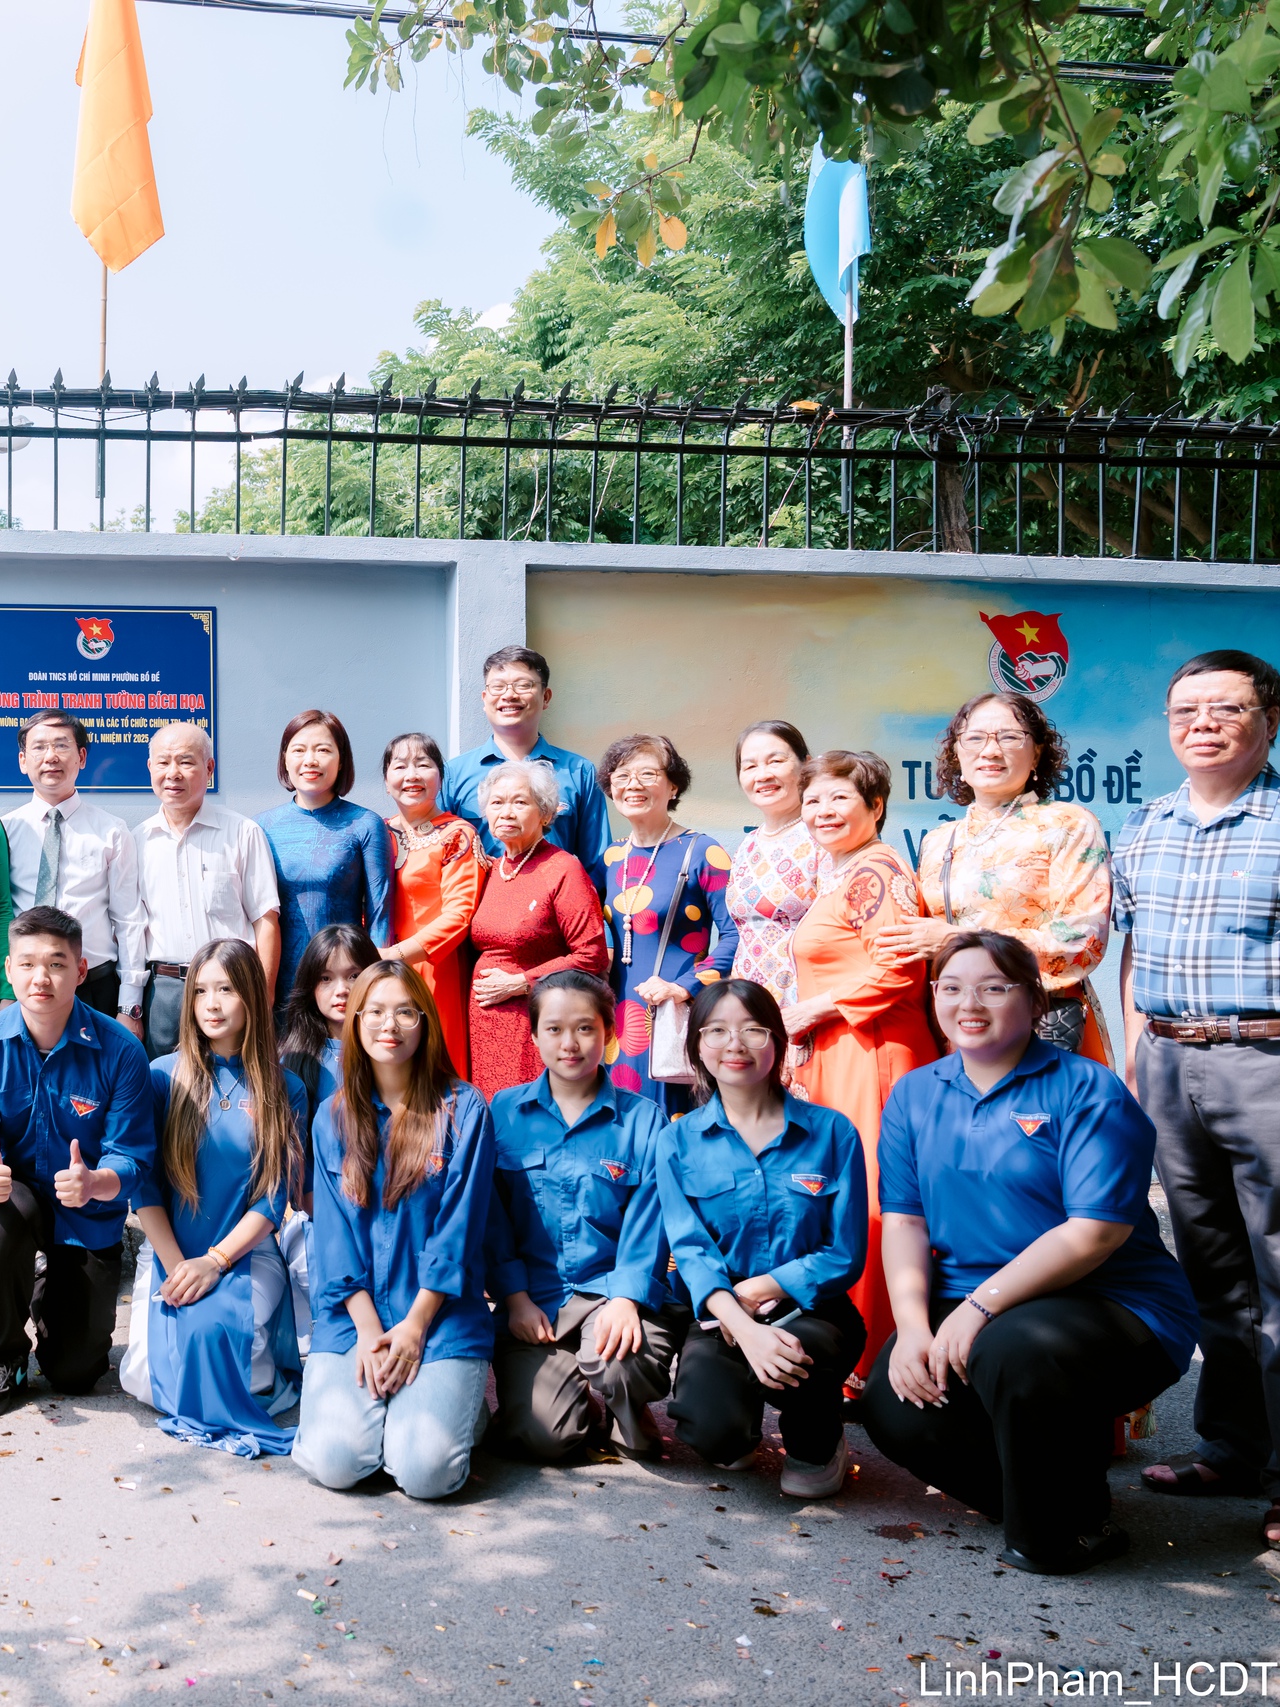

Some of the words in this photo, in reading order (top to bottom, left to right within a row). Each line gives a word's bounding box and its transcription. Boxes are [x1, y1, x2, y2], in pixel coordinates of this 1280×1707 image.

[49, 672, 66, 681] TNCS
[92, 673, 110, 682] MINH
[22, 690, 59, 708] TRÌNH
[62, 693, 102, 709] TRANH
[104, 690, 145, 709] TƯỜNG
[148, 691, 177, 709] BÍCH
[179, 693, 206, 712] HỌA
[96, 716, 105, 728] VÀ
[106, 716, 119, 728] CÁC
[100, 732, 122, 745] NHIỆM
[133, 733, 149, 743] 2025
[1054, 748, 1097, 803] BỒ
[1102, 749, 1143, 804] ĐỀ
